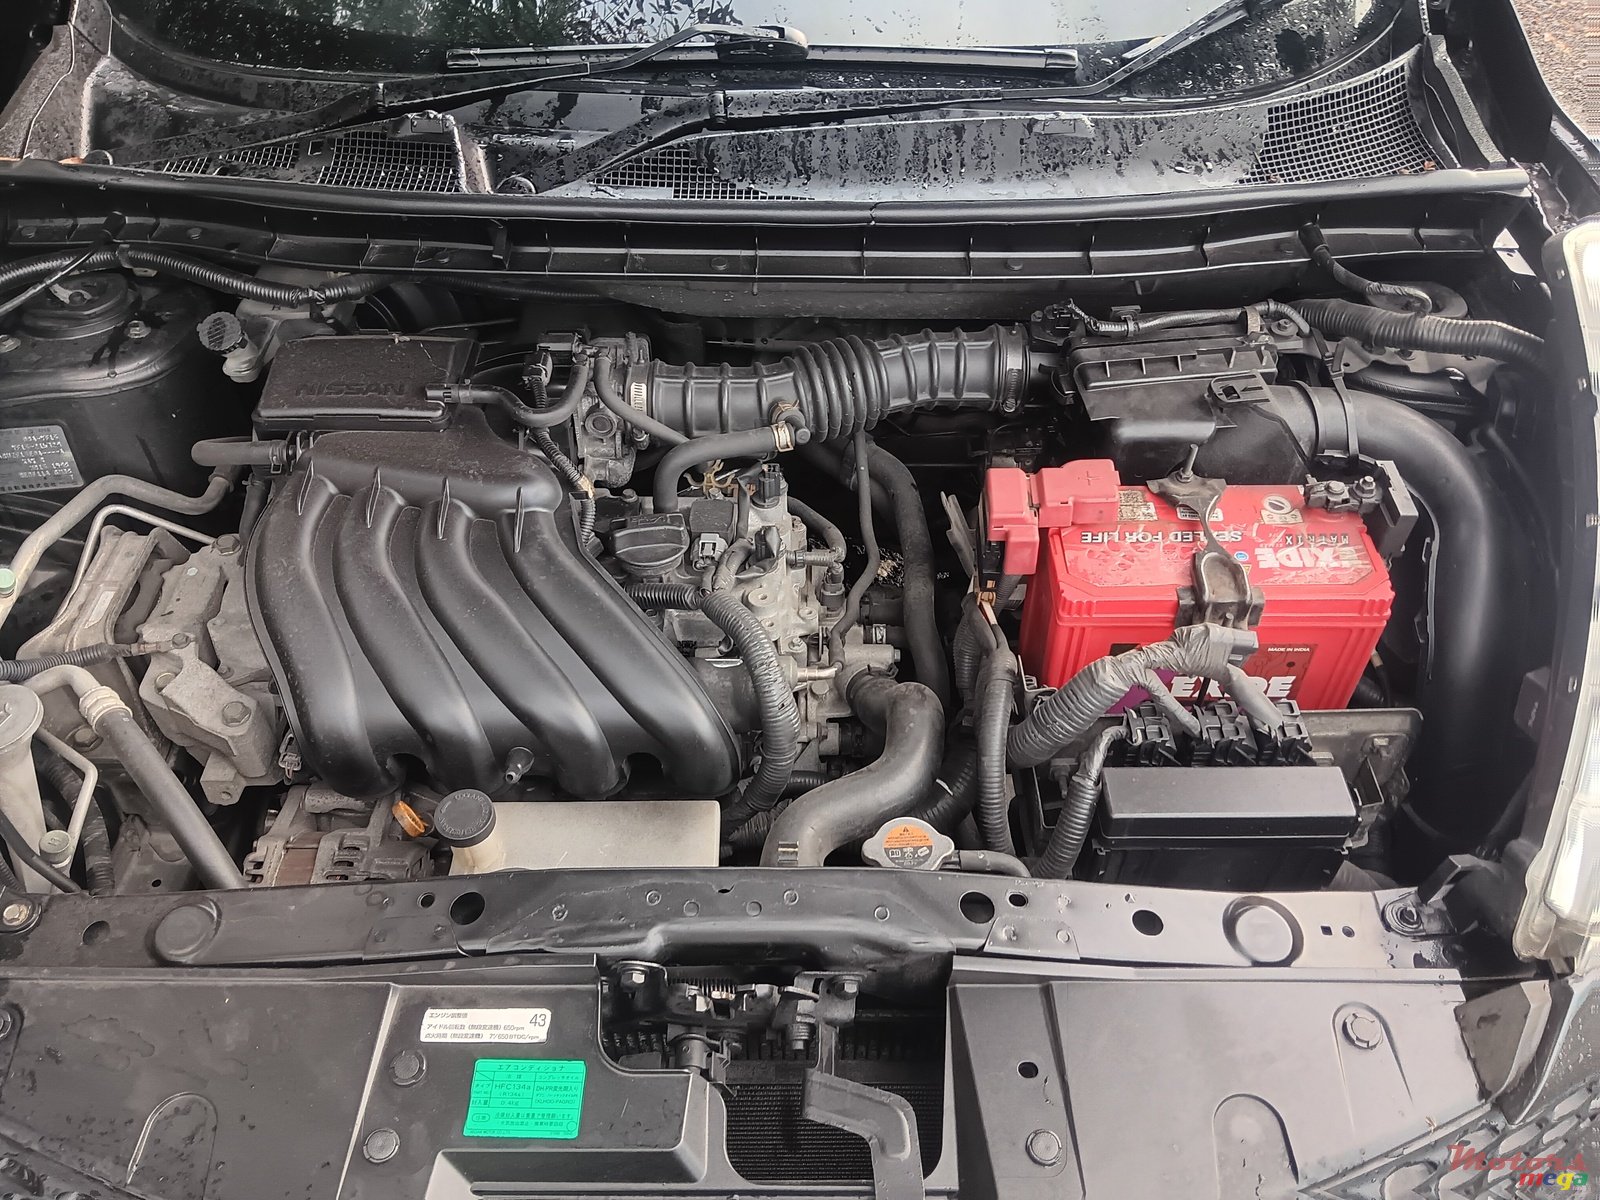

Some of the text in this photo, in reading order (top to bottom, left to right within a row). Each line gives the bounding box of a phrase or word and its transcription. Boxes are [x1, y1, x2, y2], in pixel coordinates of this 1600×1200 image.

[295, 382, 405, 398] NISSAN
[1081, 530, 1243, 543] SELED FOR LIFE
[1285, 534, 1350, 546] MATRIX
[1170, 675, 1297, 698] EXE
[529, 1013, 547, 1027] 43
